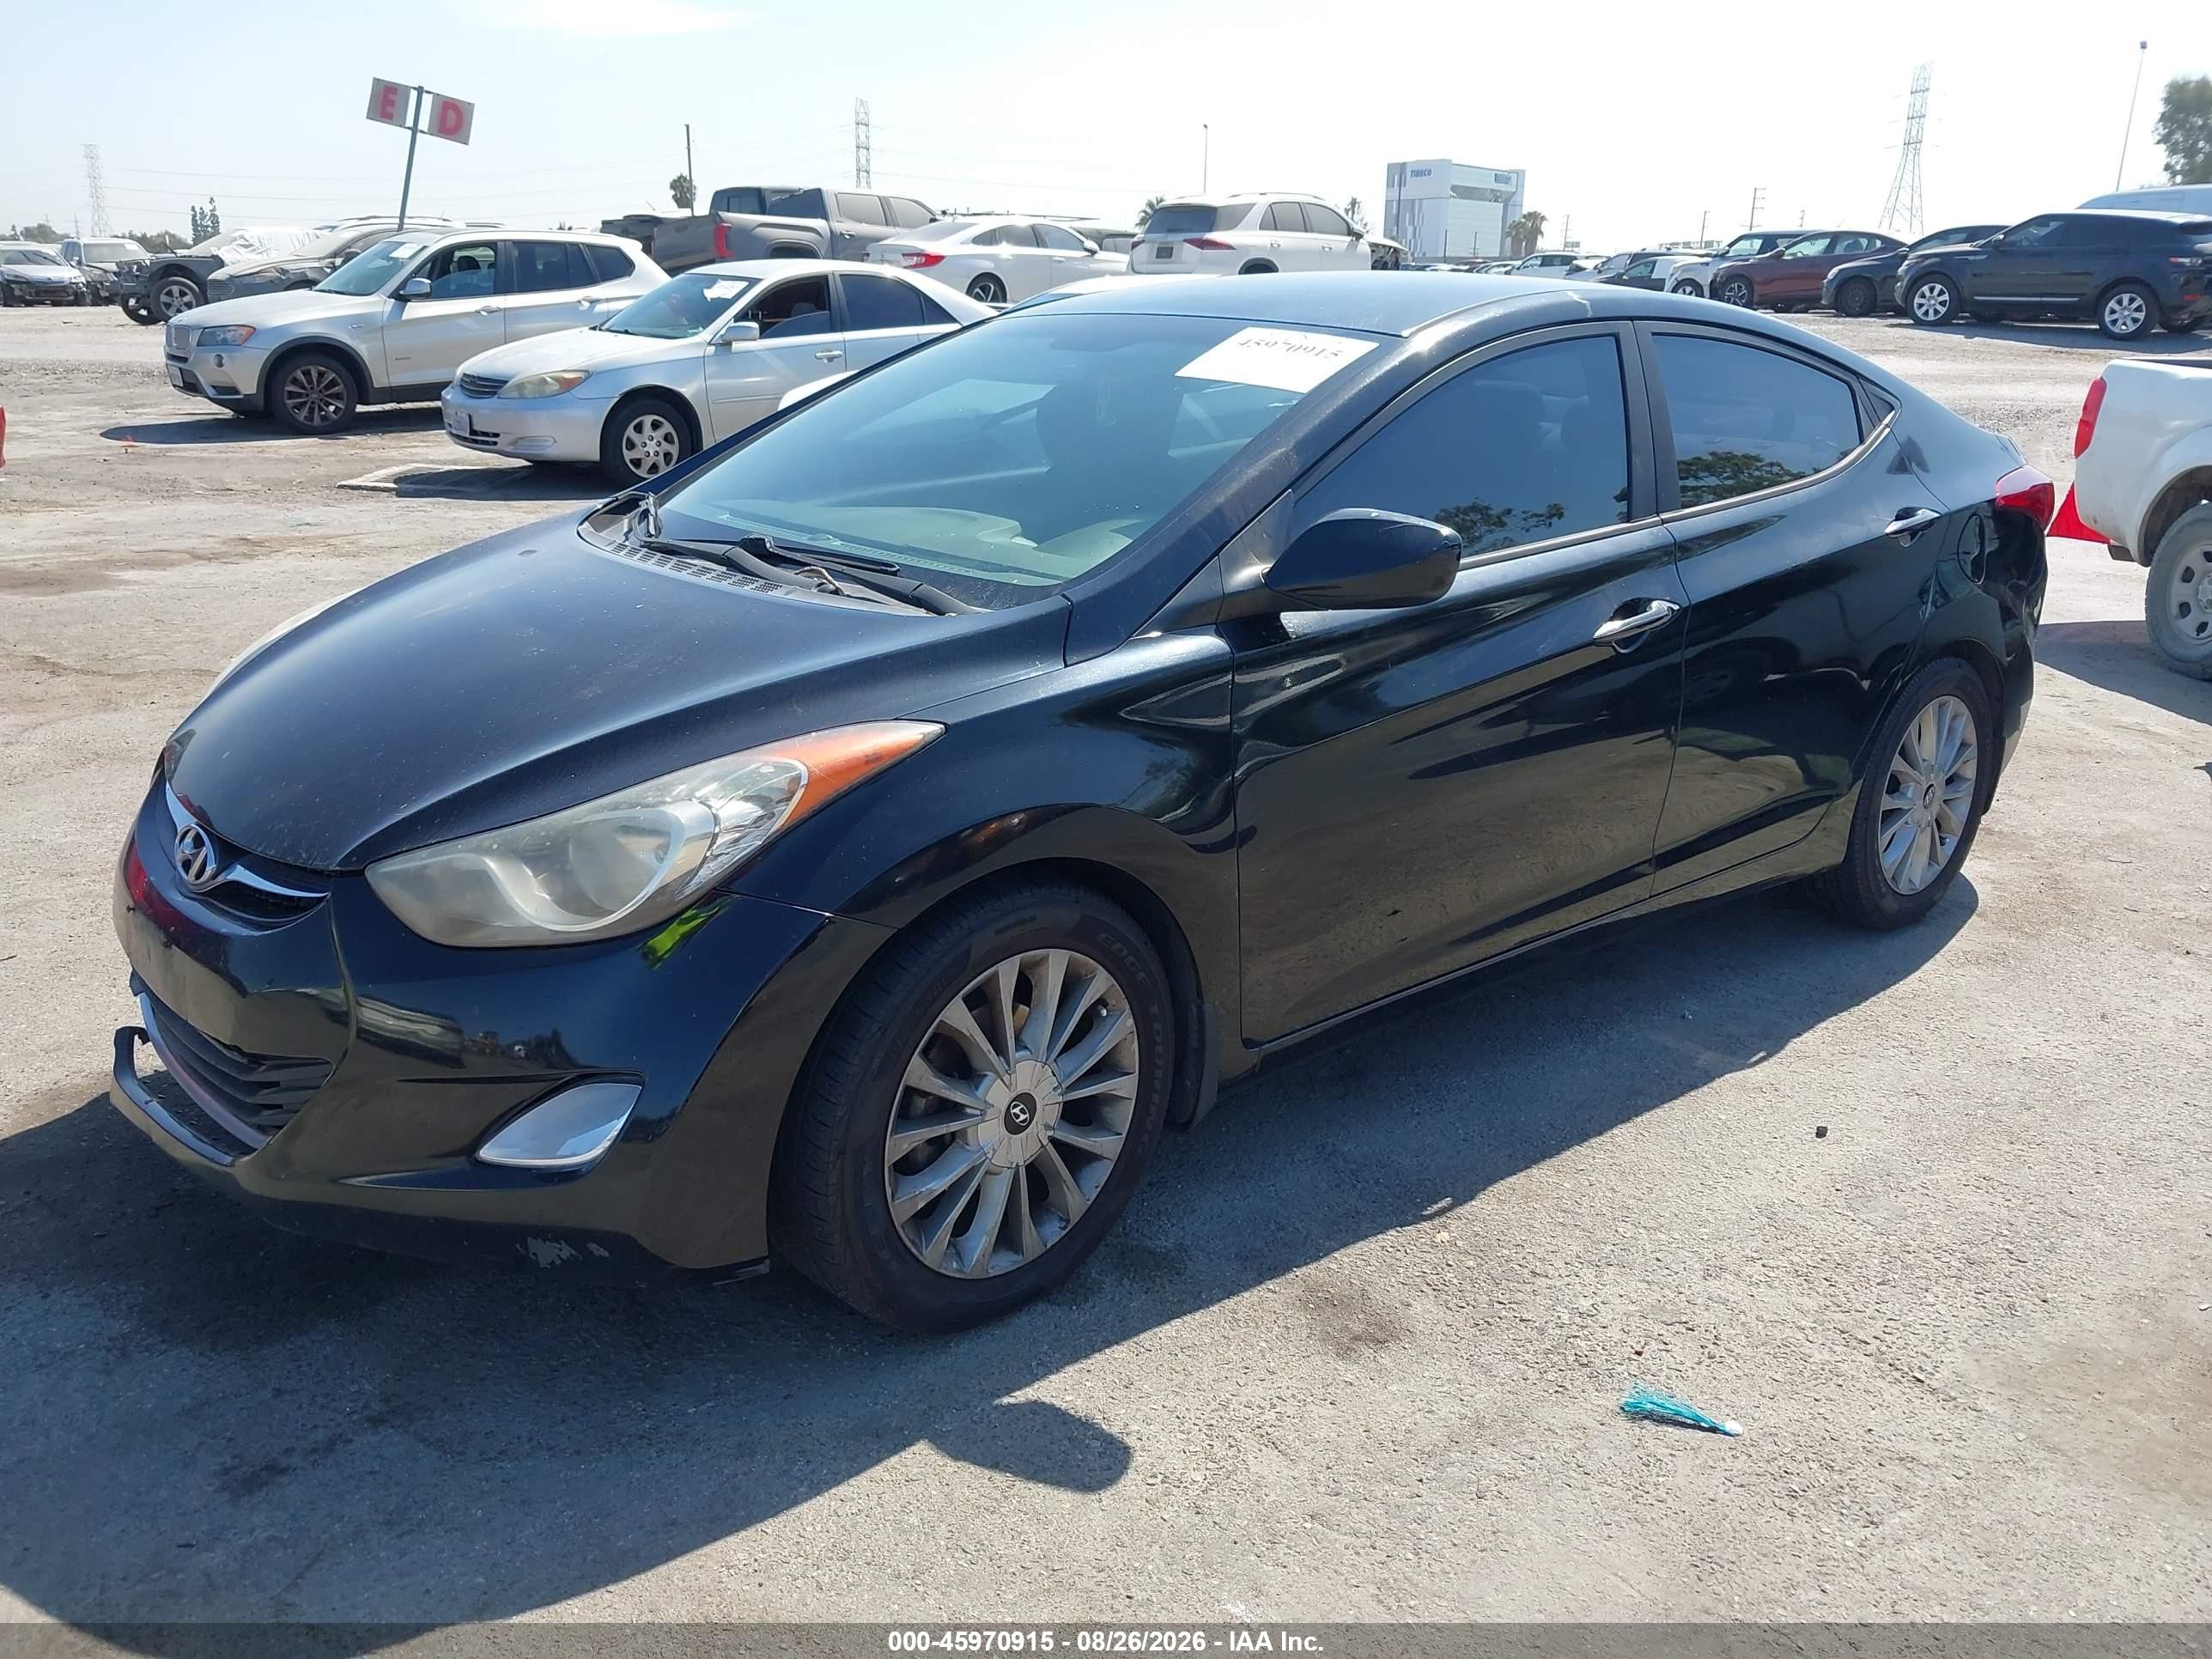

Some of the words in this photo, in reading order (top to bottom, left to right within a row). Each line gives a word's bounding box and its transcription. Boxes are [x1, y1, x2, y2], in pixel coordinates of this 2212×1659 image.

[379, 85, 398, 120] E
[438, 100, 464, 137] D
[1096, 933, 1152, 990] EDGE
